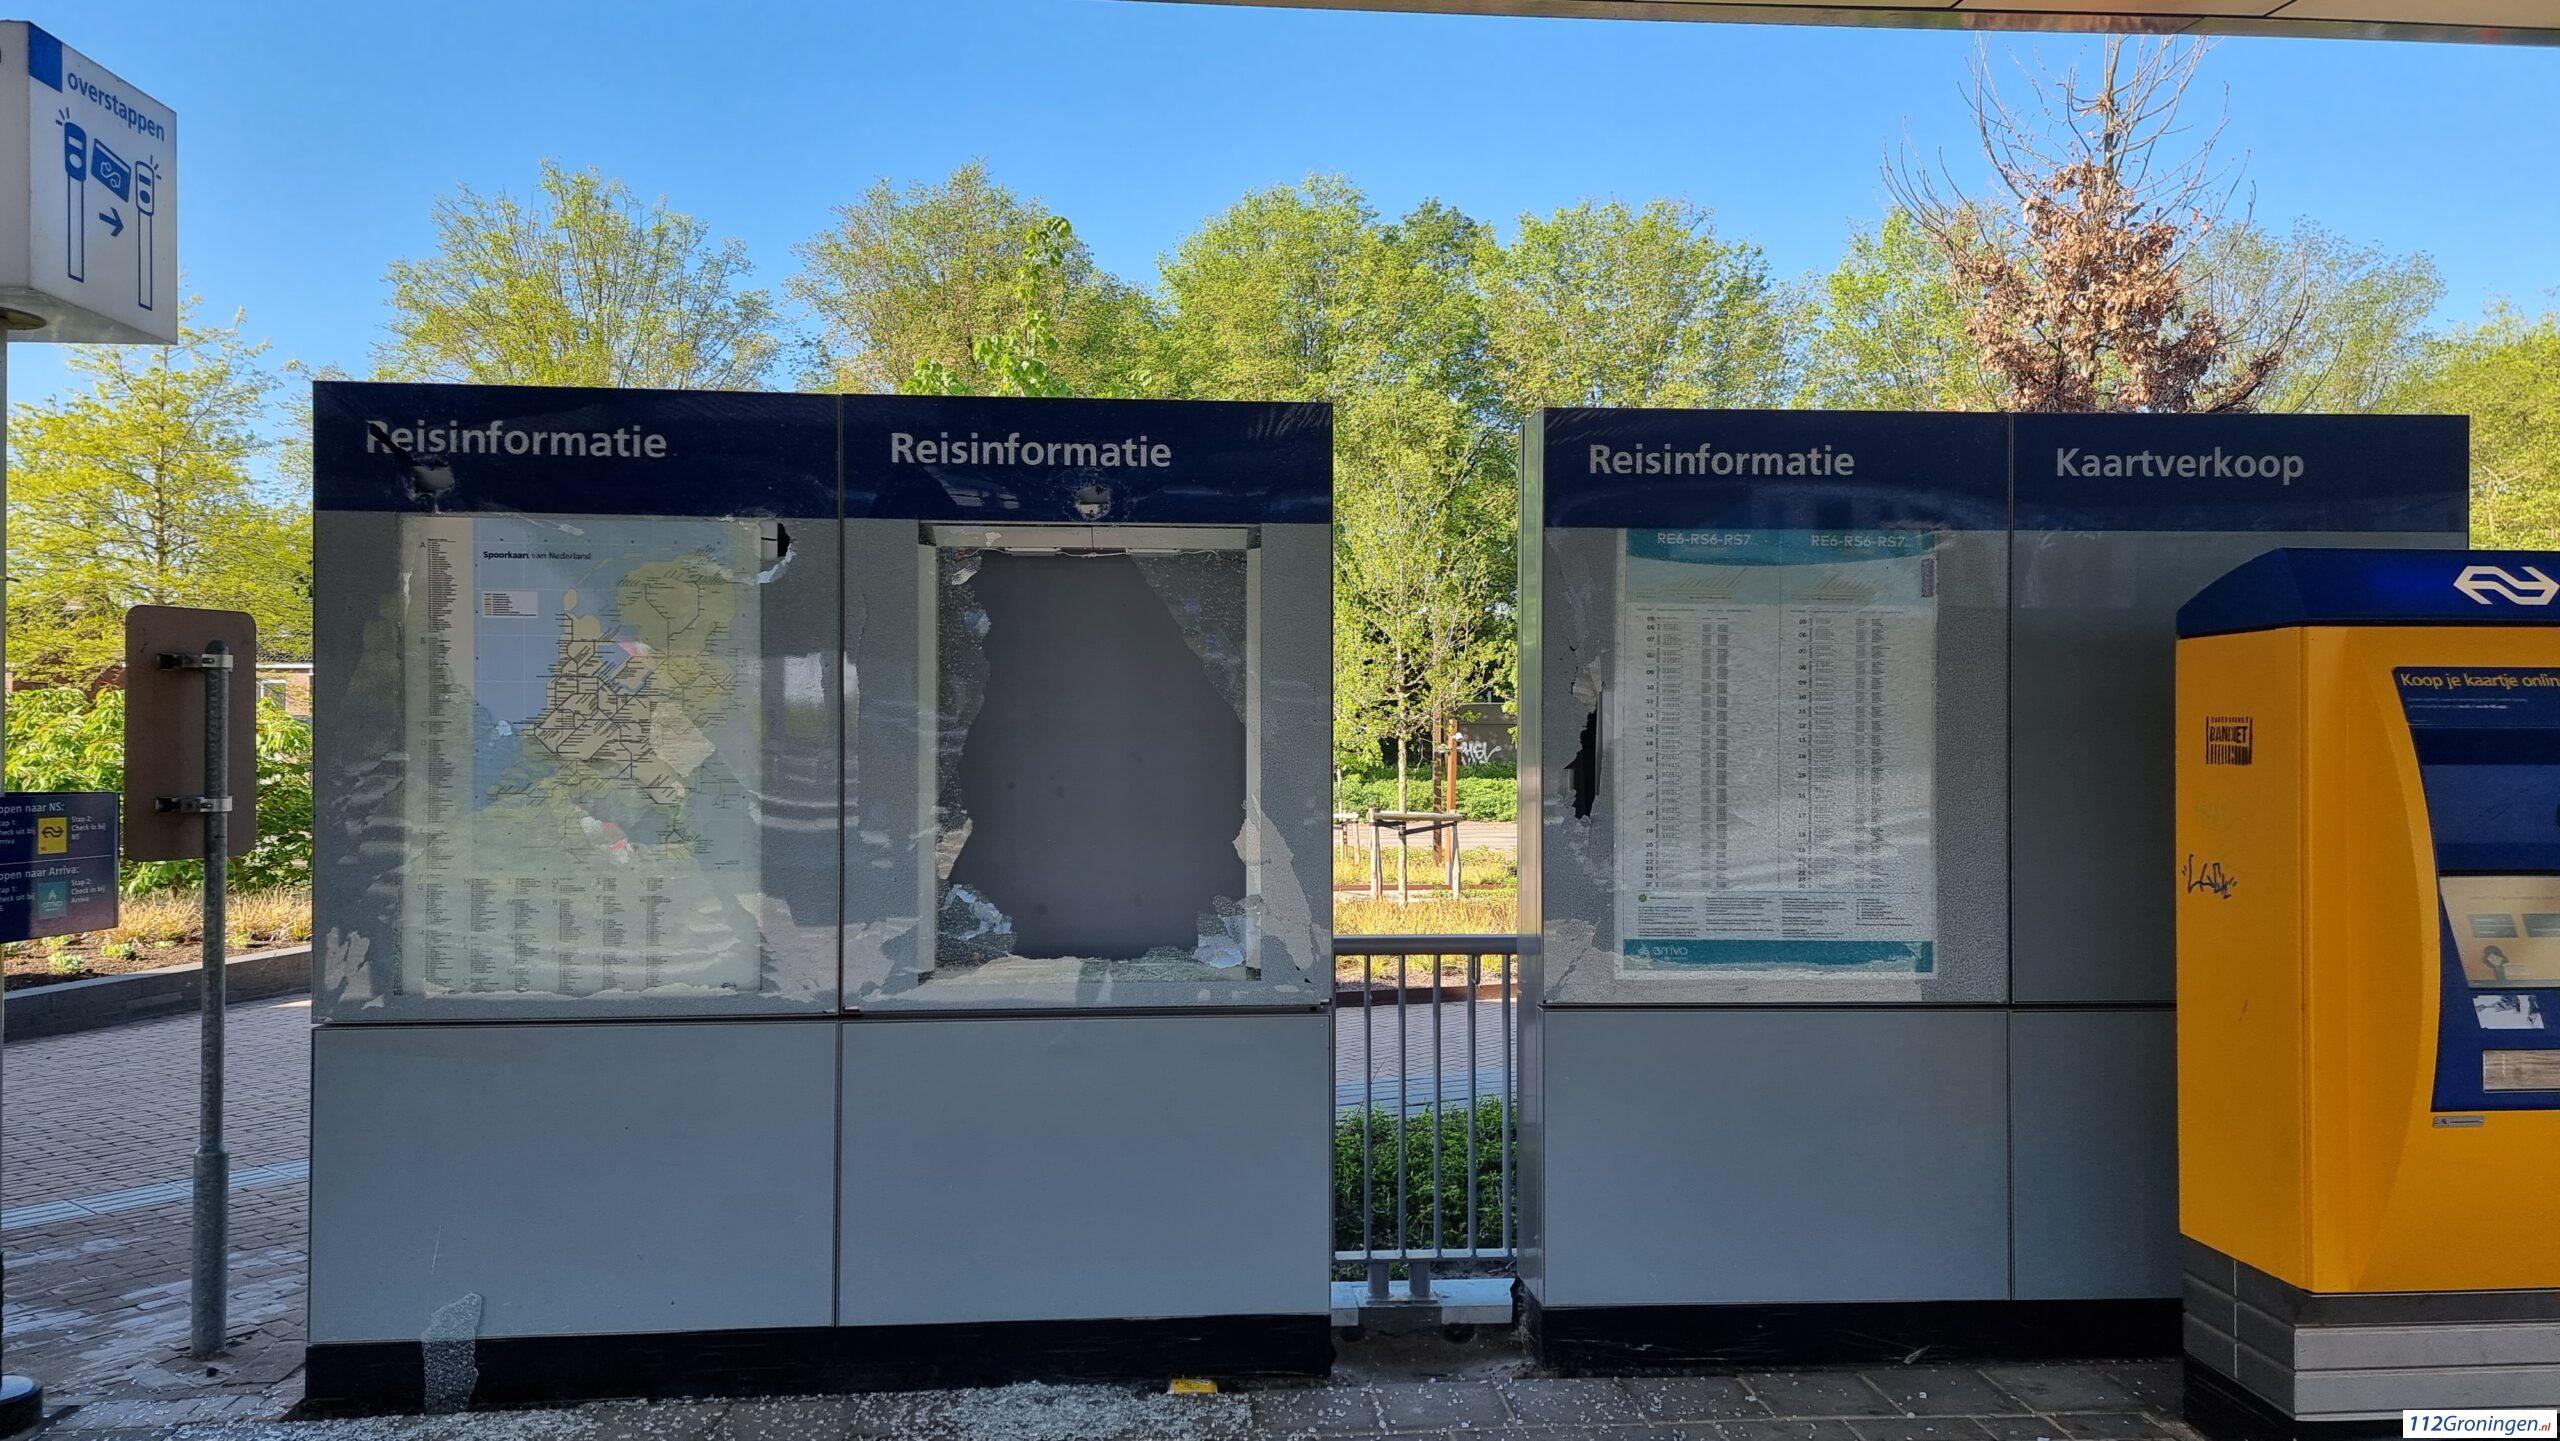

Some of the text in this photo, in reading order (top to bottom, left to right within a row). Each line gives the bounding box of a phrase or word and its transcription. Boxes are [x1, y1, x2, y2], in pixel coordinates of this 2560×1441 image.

[68, 72, 165, 142] overstappen
[366, 419, 667, 458] Reisinformatie
[891, 432, 1172, 467] Reisinformatie
[1589, 443, 1855, 476] Reisinformatie
[2057, 446, 2305, 486] Kaartverkoop
[1657, 532, 1751, 546] RE6-RS6-RS7
[1811, 534, 1906, 548] RE6-RS6-RS7
[548, 551, 592, 560] Nederland
[2400, 673, 2443, 690] Koop
[2445, 673, 2462, 690] je
[2463, 673, 2520, 690] kaartje
[25, 804, 47, 813] naar
[49, 802, 65, 812] NS:
[25, 869, 47, 878] naar
[49, 865, 80, 876] Arriva:
